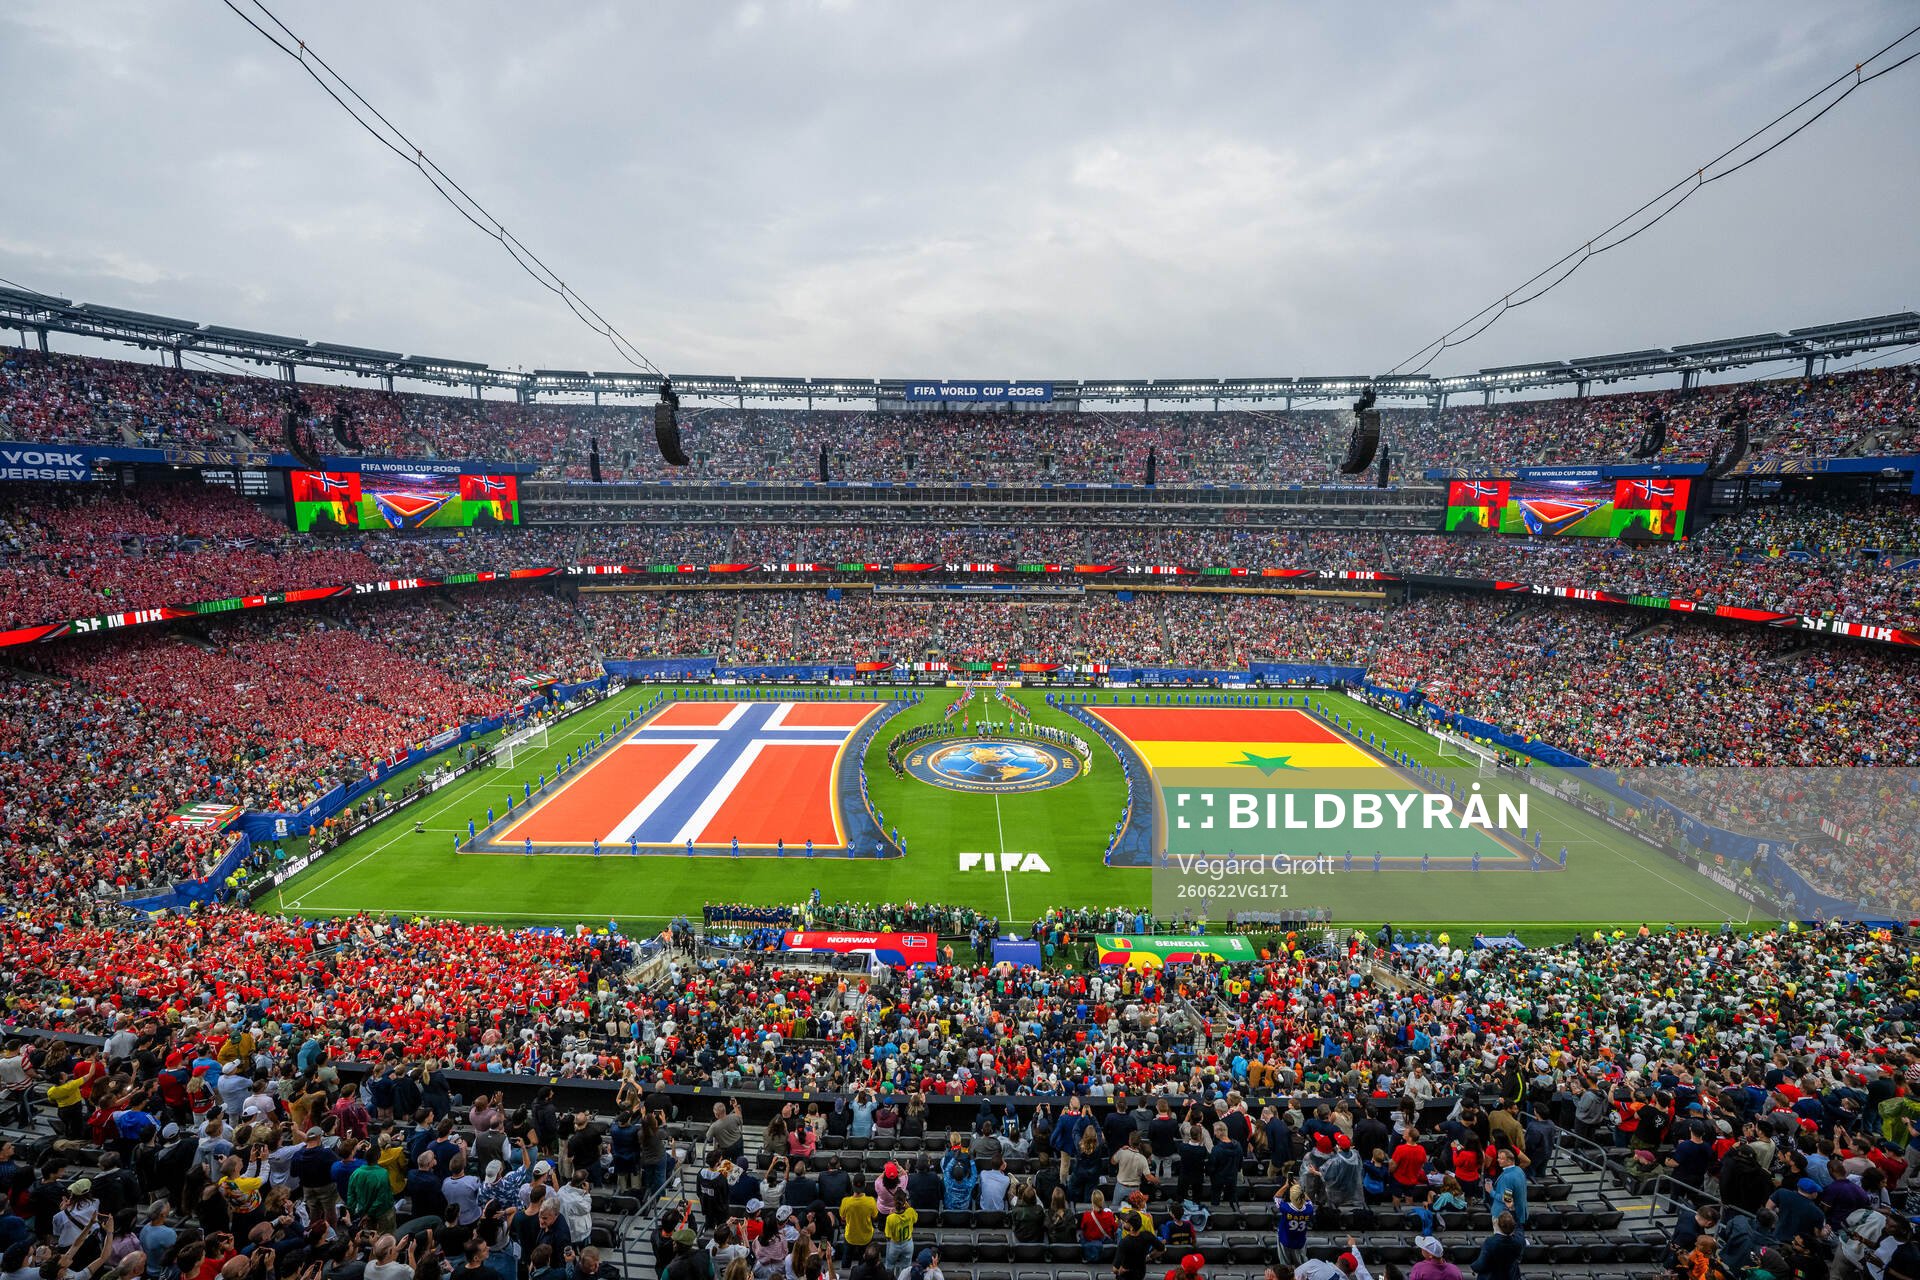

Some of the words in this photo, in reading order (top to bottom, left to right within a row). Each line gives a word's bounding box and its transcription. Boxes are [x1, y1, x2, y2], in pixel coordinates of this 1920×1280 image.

[914, 386, 936, 396] FIFA
[940, 386, 976, 396] WORLD
[983, 387, 1004, 396] CUP
[1008, 387, 1044, 396] 2026
[1, 450, 85, 466] YORK
[0, 468, 86, 480] JERSEY
[310, 806, 320, 816] FIFA
[274, 873, 284, 886] NO
[288, 856, 308, 879] RACISM
[310, 849, 324, 862] FIFA
[960, 853, 1051, 872] FIFA
[1698, 862, 1707, 876] NO
[1712, 870, 1737, 893] RACISM
[1738, 887, 1755, 902] FIFA
[1289, 1220, 1306, 1231] 93
